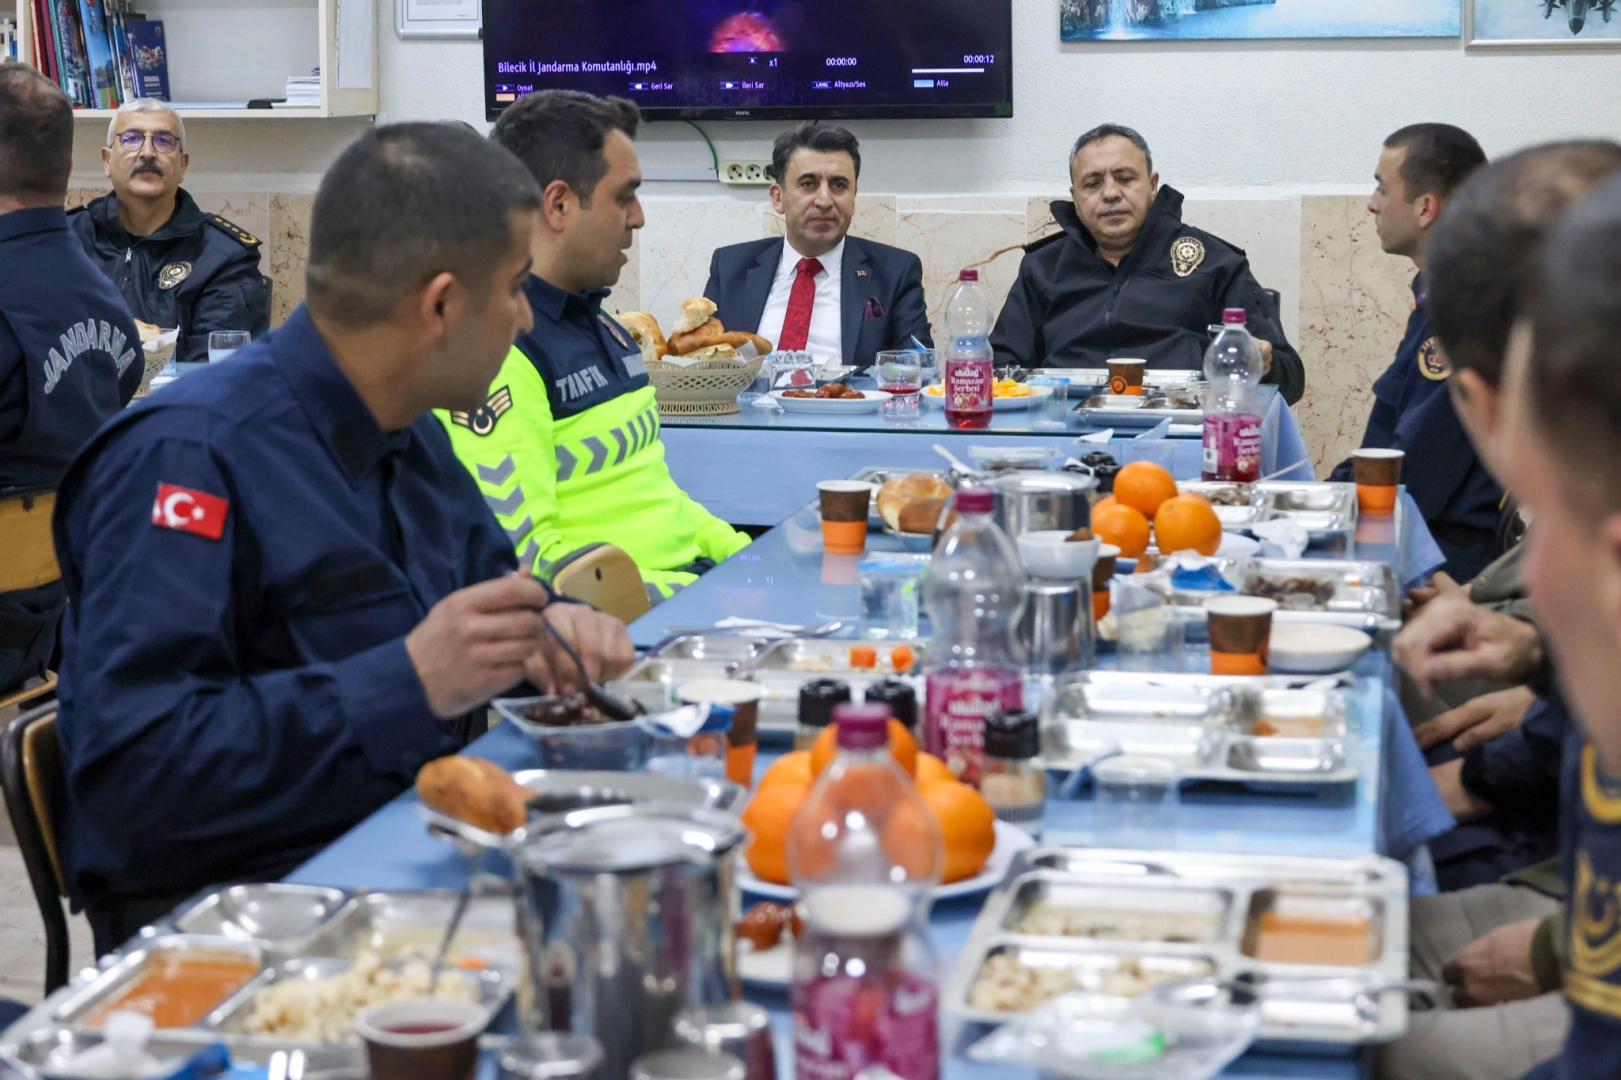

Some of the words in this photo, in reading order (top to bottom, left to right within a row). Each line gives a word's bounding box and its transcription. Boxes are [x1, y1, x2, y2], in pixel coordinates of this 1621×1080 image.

[768, 58, 778, 67] x1
[826, 57, 858, 66] 00:00:00
[963, 55, 995, 64] 00:00:12
[498, 62, 527, 73] Bilecik
[529, 59, 536, 73] İl
[537, 61, 580, 75] Jandarma
[582, 60, 658, 75] Komutanlığı.mp4
[517, 84, 533, 92] Oynat
[741, 81, 754, 89] İleri
[834, 80, 866, 89] Altyazı/Ses
[44, 318, 136, 394] JANDARMA
[951, 377, 984, 385] Ramazan
